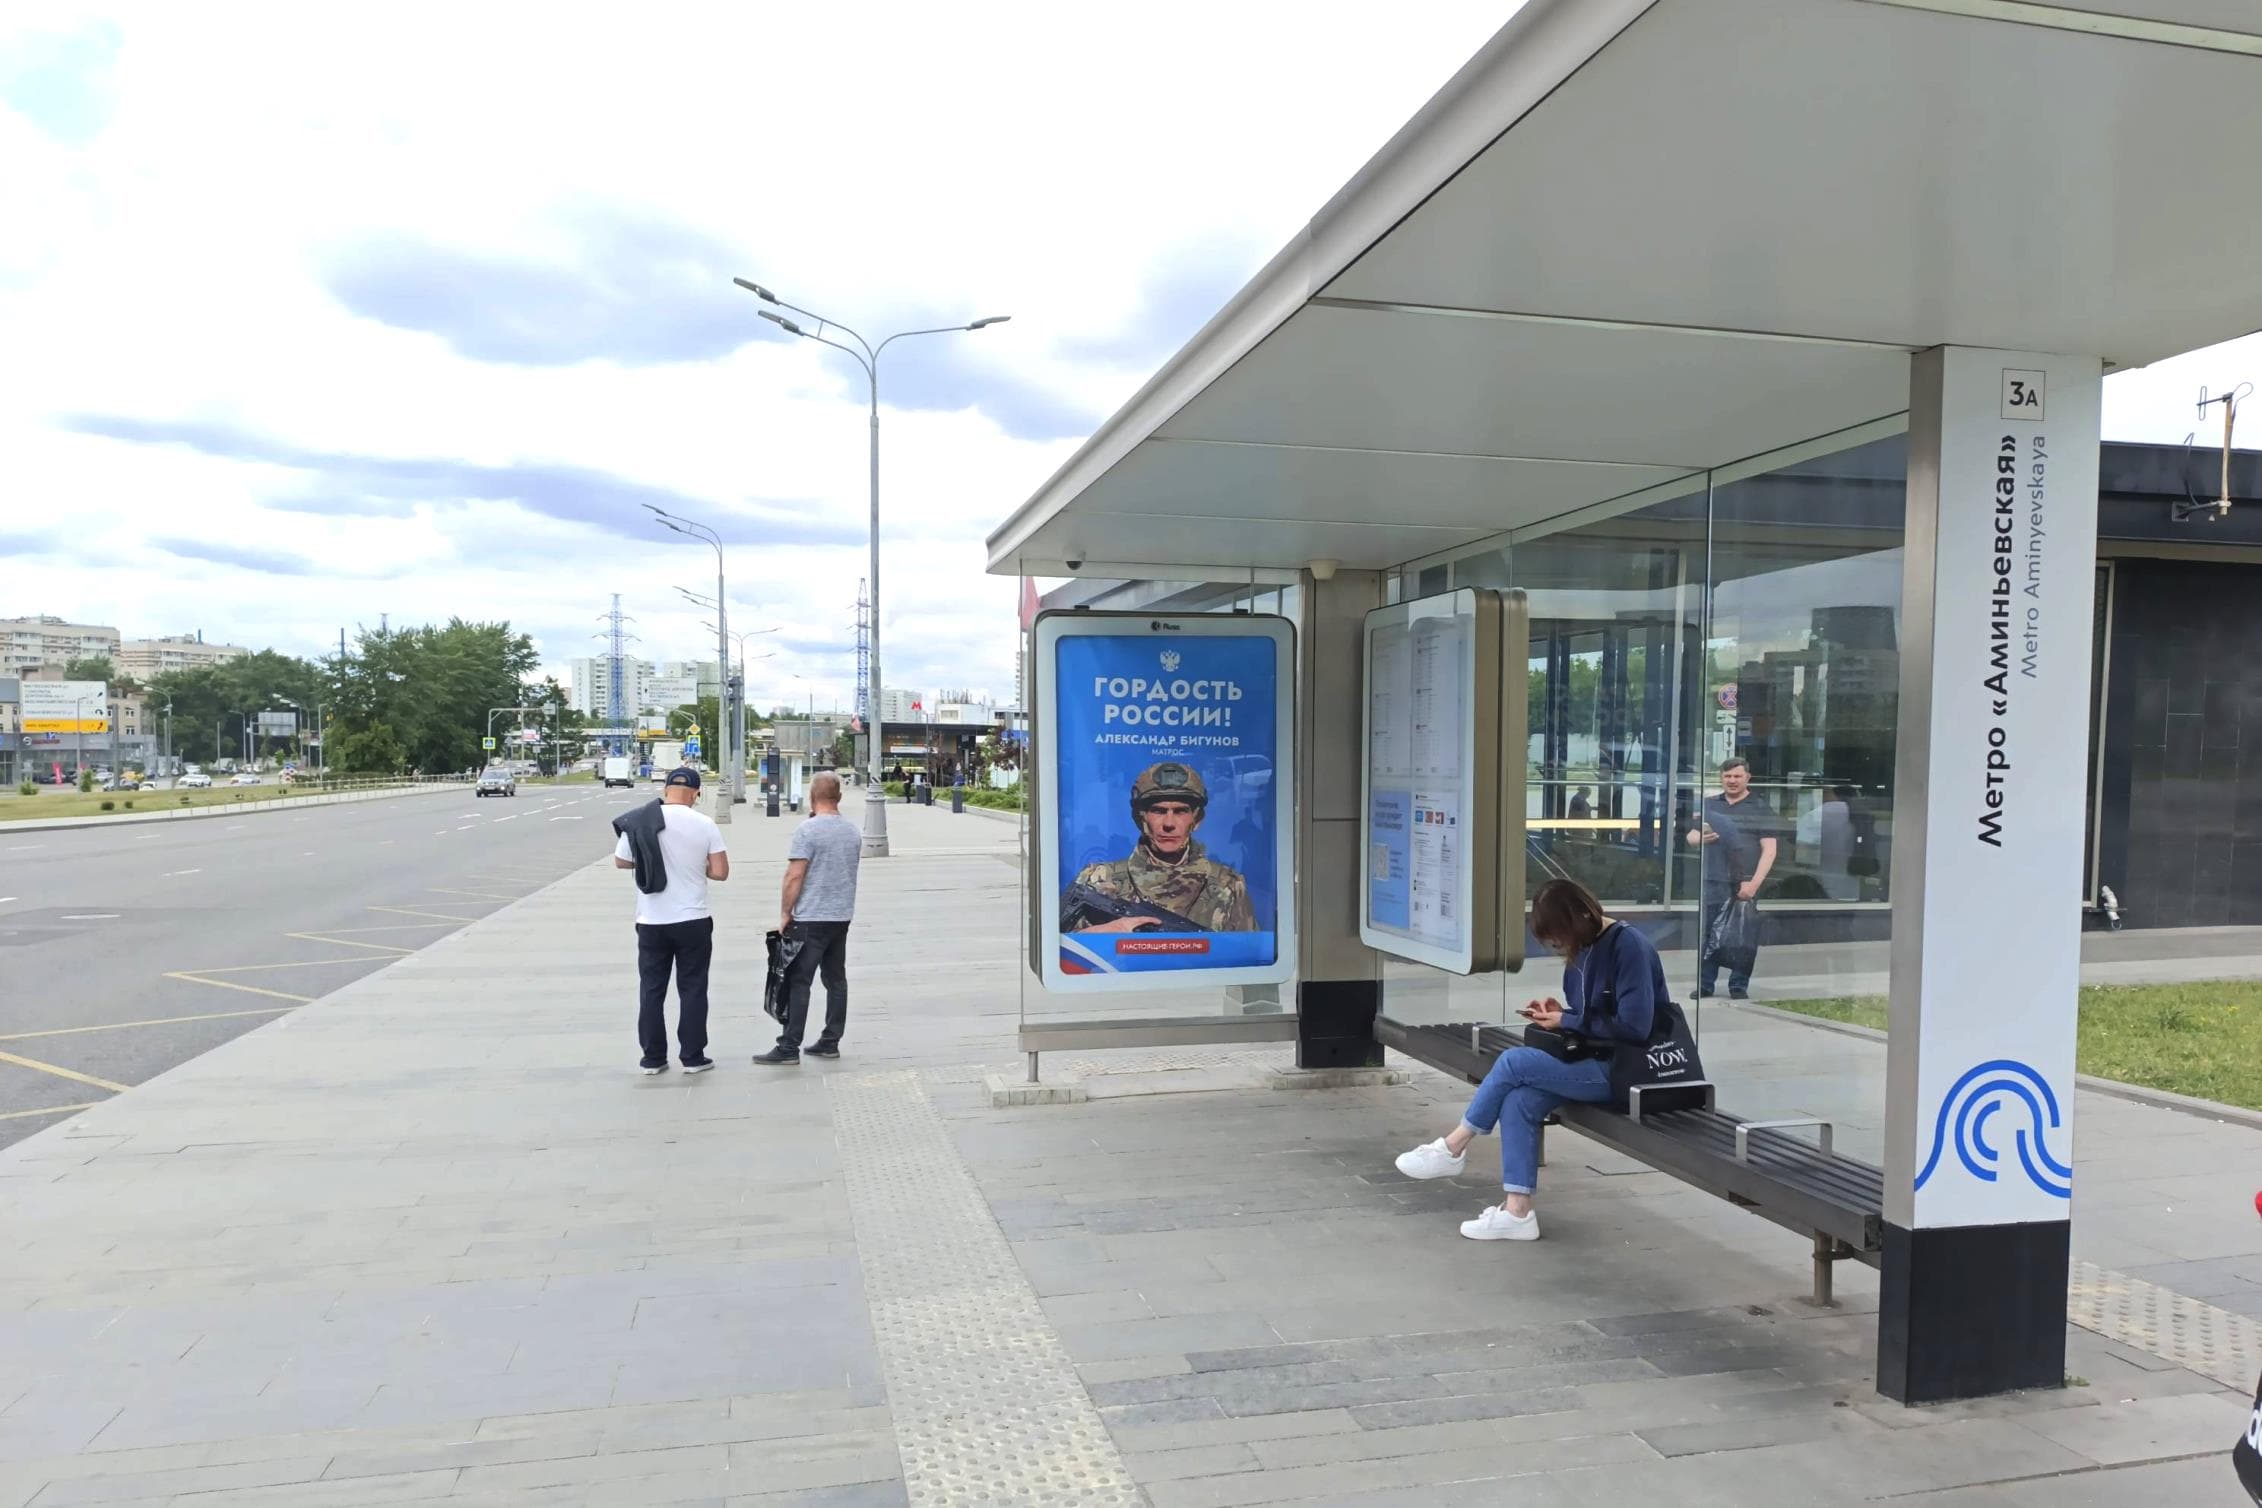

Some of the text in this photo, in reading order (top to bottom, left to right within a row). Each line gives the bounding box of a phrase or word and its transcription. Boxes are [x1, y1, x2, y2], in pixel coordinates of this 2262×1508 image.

[2021, 436, 2049, 679] Metro Aminyevskaya
[1978, 435, 2016, 848] Метро «Аминьевская»
[1094, 677, 1243, 702] ГОРДОСТЬ
[1104, 704, 1232, 727] РОССИИ!
[1095, 733, 1240, 746] АЛЕКСАНДР БИГУНОВ
[1151, 749, 1184, 757] МАТРОС
